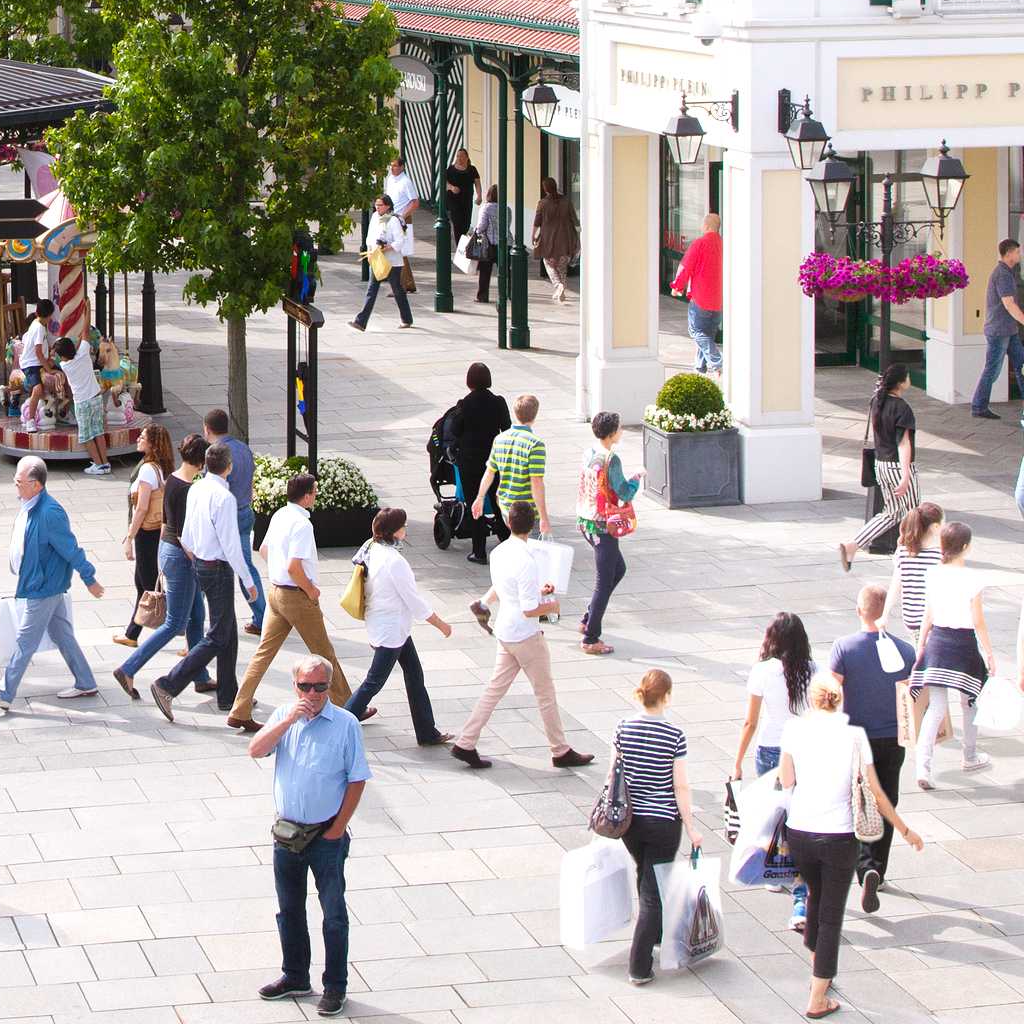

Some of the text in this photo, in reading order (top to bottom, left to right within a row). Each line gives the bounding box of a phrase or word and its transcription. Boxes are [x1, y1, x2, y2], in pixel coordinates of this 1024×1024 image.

[620, 68, 709, 96] PHILIPP PLEIN
[860, 83, 989, 103] PHILIPP
